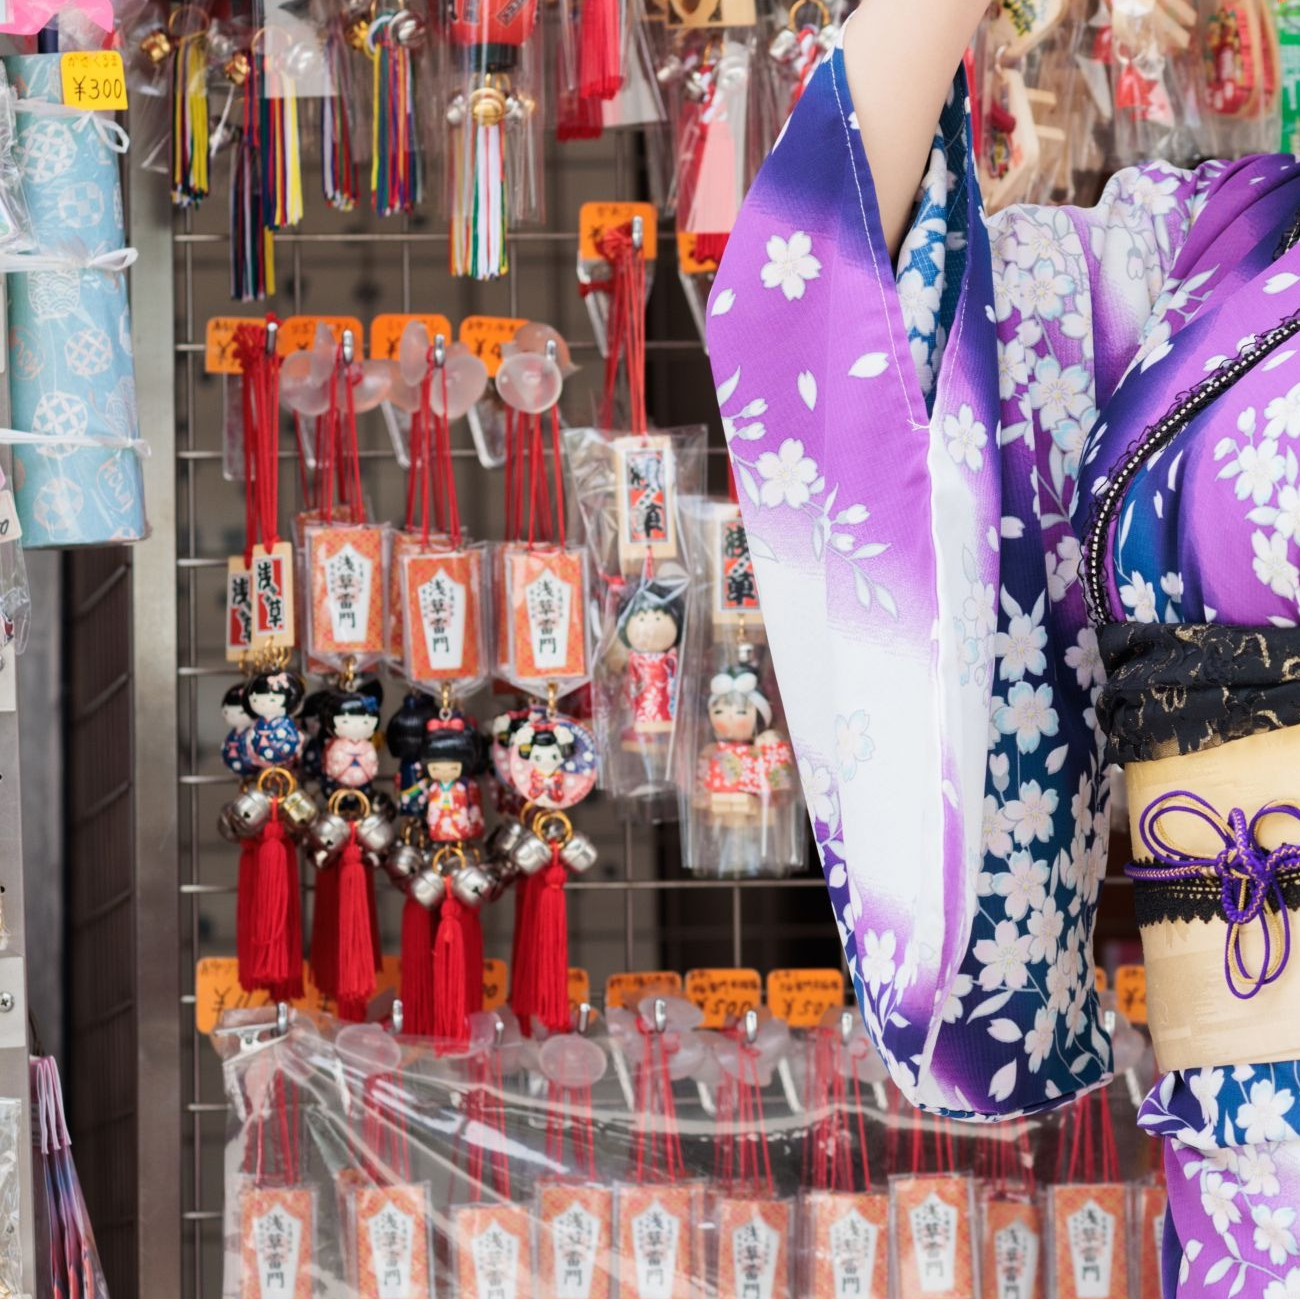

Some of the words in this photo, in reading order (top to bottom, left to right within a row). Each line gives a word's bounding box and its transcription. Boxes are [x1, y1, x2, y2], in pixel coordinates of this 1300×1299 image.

[72, 75, 123, 102] ¥300
[336, 554, 357, 630] 浅草雷門
[429, 579, 450, 654] 浅草雷門
[537, 580, 557, 654] 浅草雷門
[265, 1214, 285, 1289] 浅草雷門
